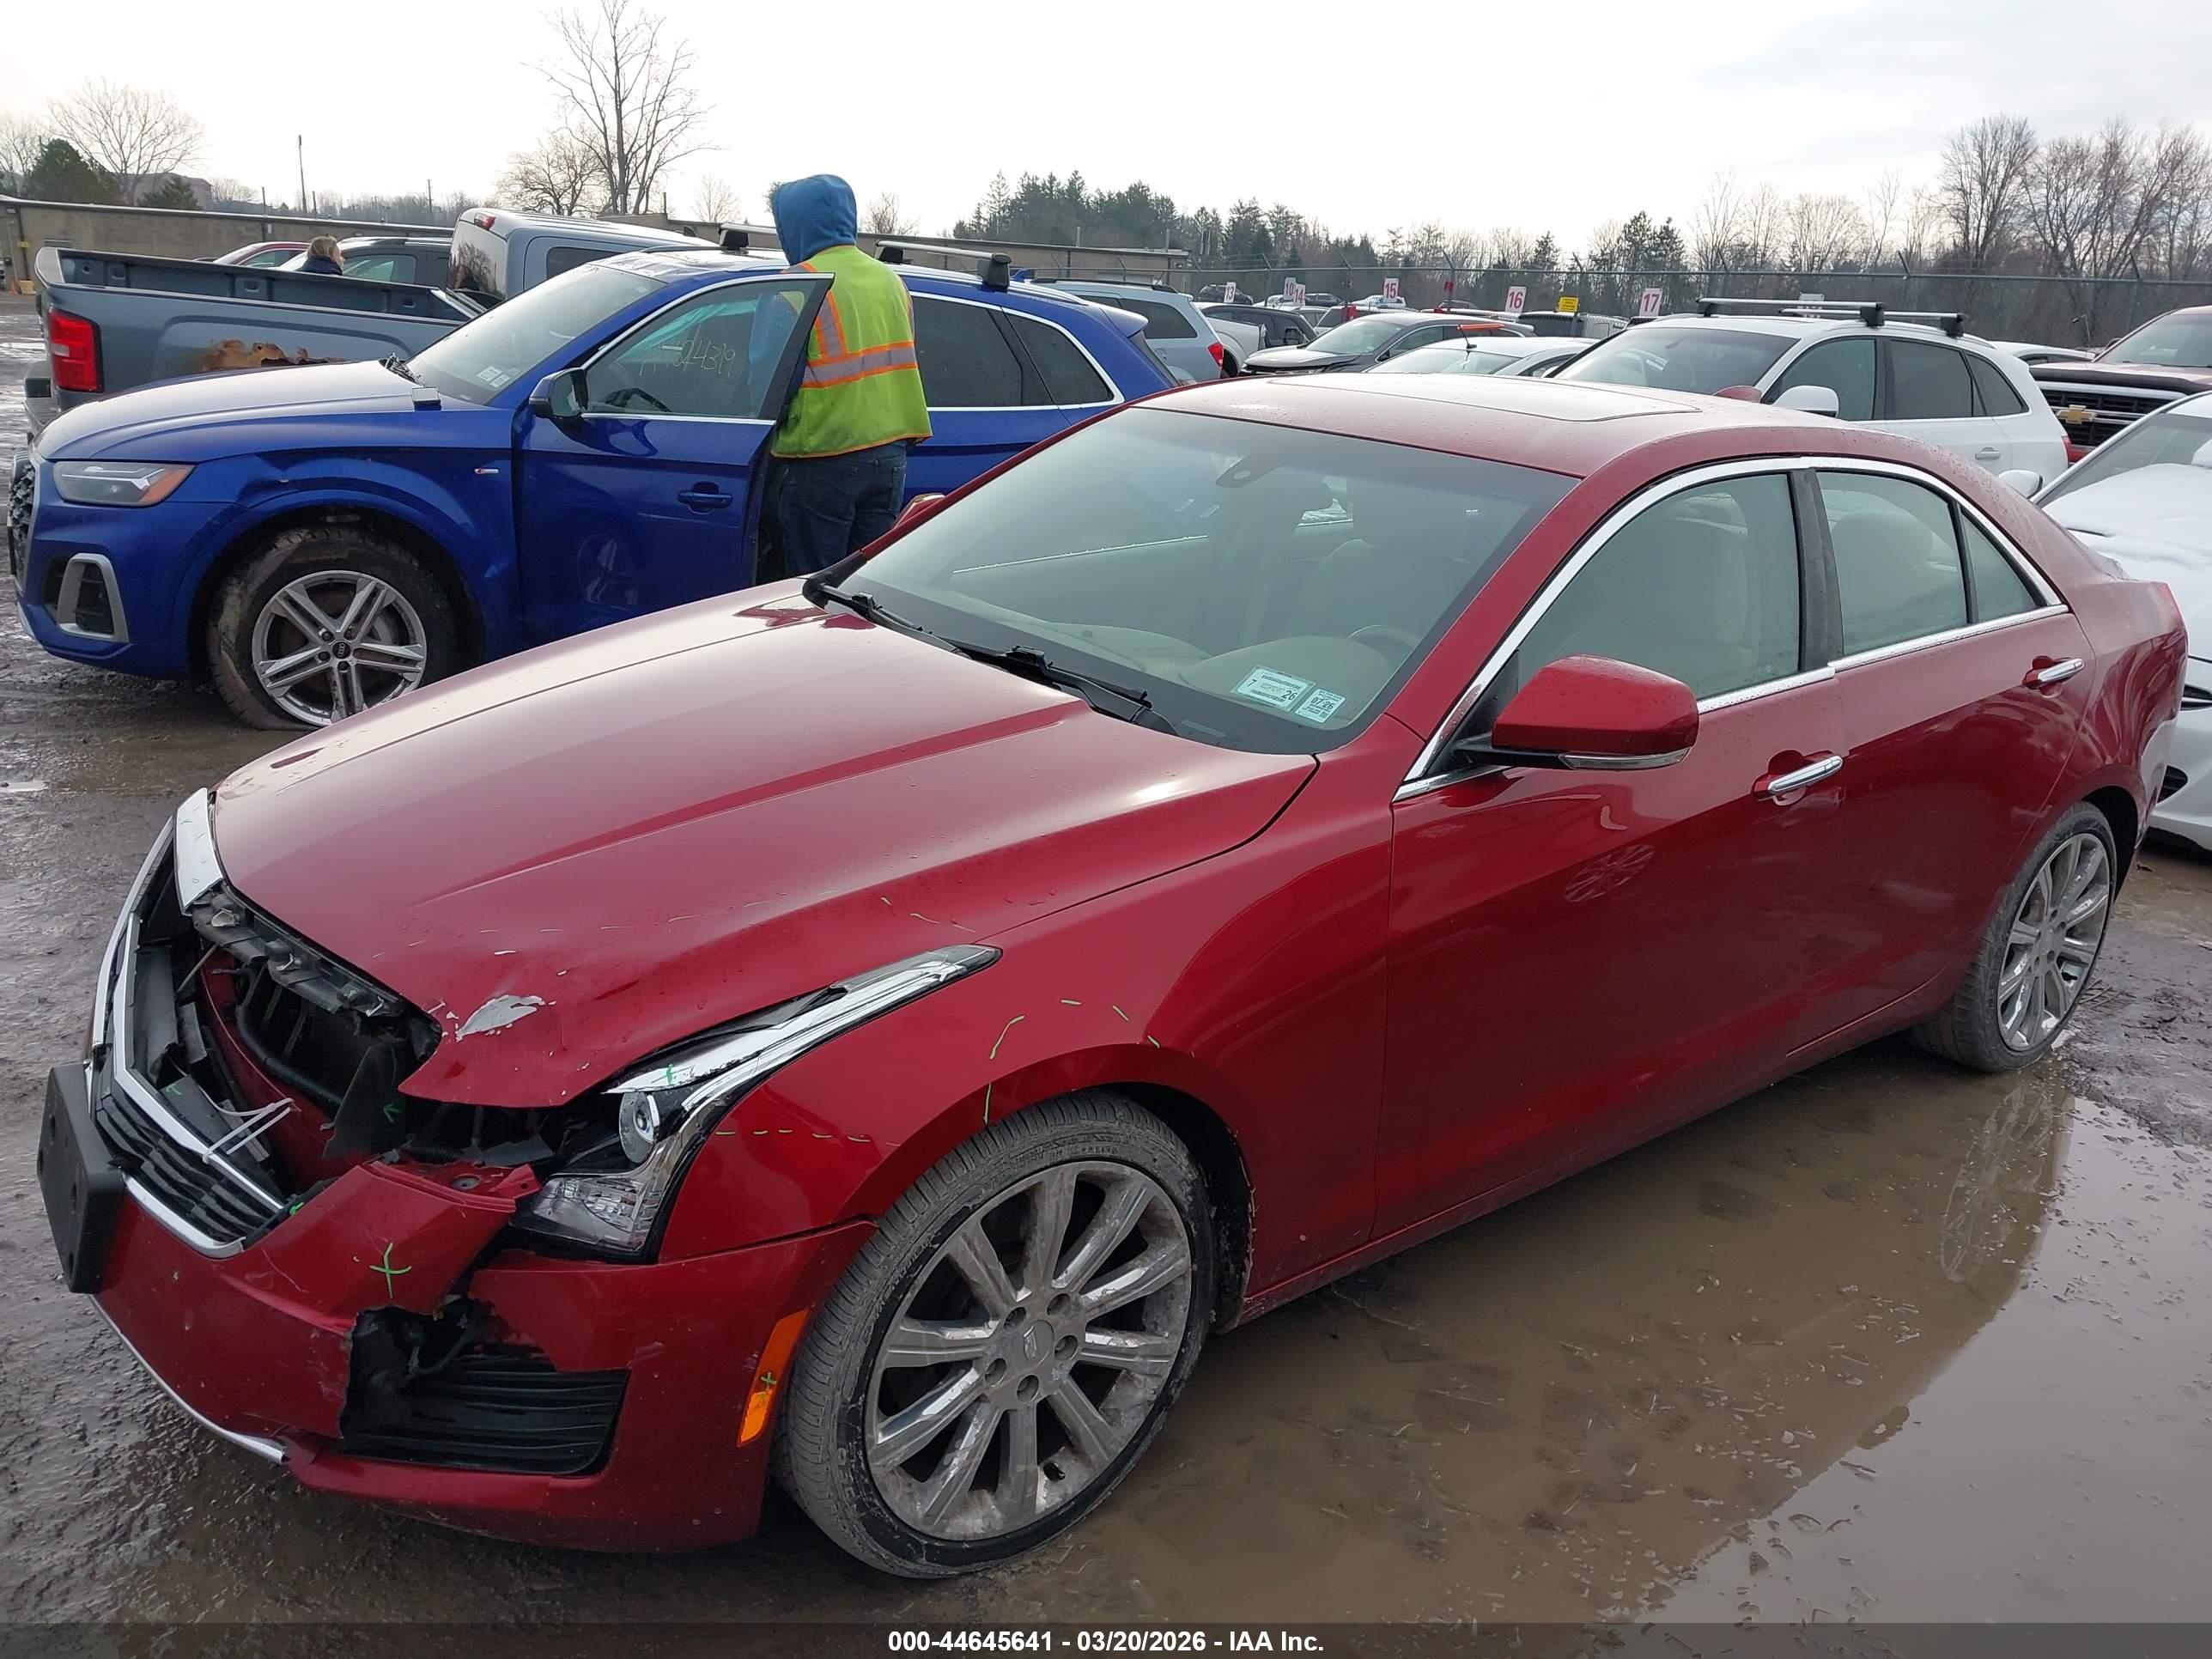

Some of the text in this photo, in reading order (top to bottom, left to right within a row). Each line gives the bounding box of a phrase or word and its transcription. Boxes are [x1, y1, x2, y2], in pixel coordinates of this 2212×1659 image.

[1225, 286, 1235, 301] 13
[1294, 289, 1304, 304] 14
[1384, 283, 1397, 299] 15
[1509, 291, 1523, 309] 16
[1644, 294, 1660, 313] 17
[1247, 678, 1257, 687] 7
[1280, 690, 1298, 701] 26
